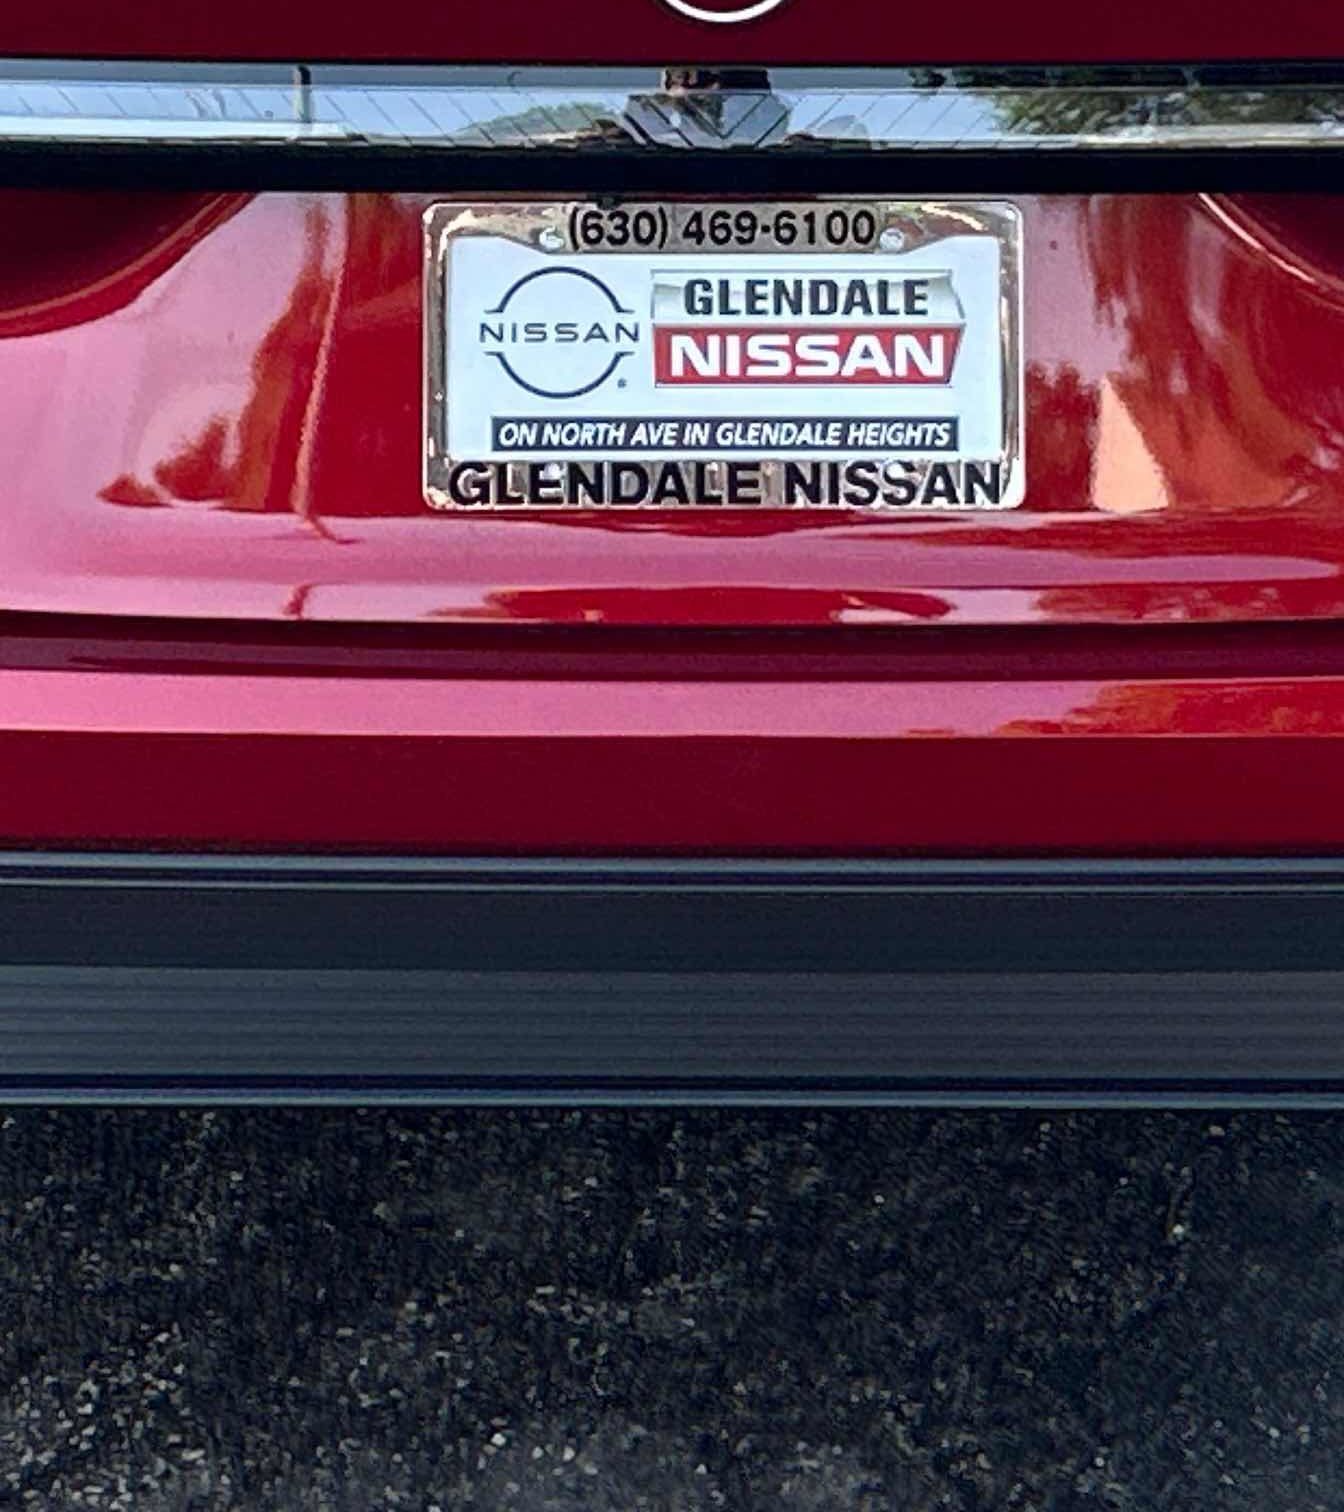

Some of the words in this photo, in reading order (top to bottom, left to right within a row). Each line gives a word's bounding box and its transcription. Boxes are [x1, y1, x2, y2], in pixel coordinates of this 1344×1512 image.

[568, 206, 668, 251] (630)
[681, 209, 875, 246] 469-6100
[684, 278, 929, 316] GLENDALE
[479, 321, 640, 344] NISSAN
[670, 334, 945, 377] NISSAN
[499, 422, 538, 447] ON
[541, 422, 627, 447] NORTH
[630, 422, 679, 447] AVE
[682, 422, 710, 447] IN
[715, 422, 841, 447] GLENDALE
[846, 422, 952, 447] HEIGHTS
[448, 460, 763, 507] GLENDALE
[783, 459, 1002, 507] NISSAN
